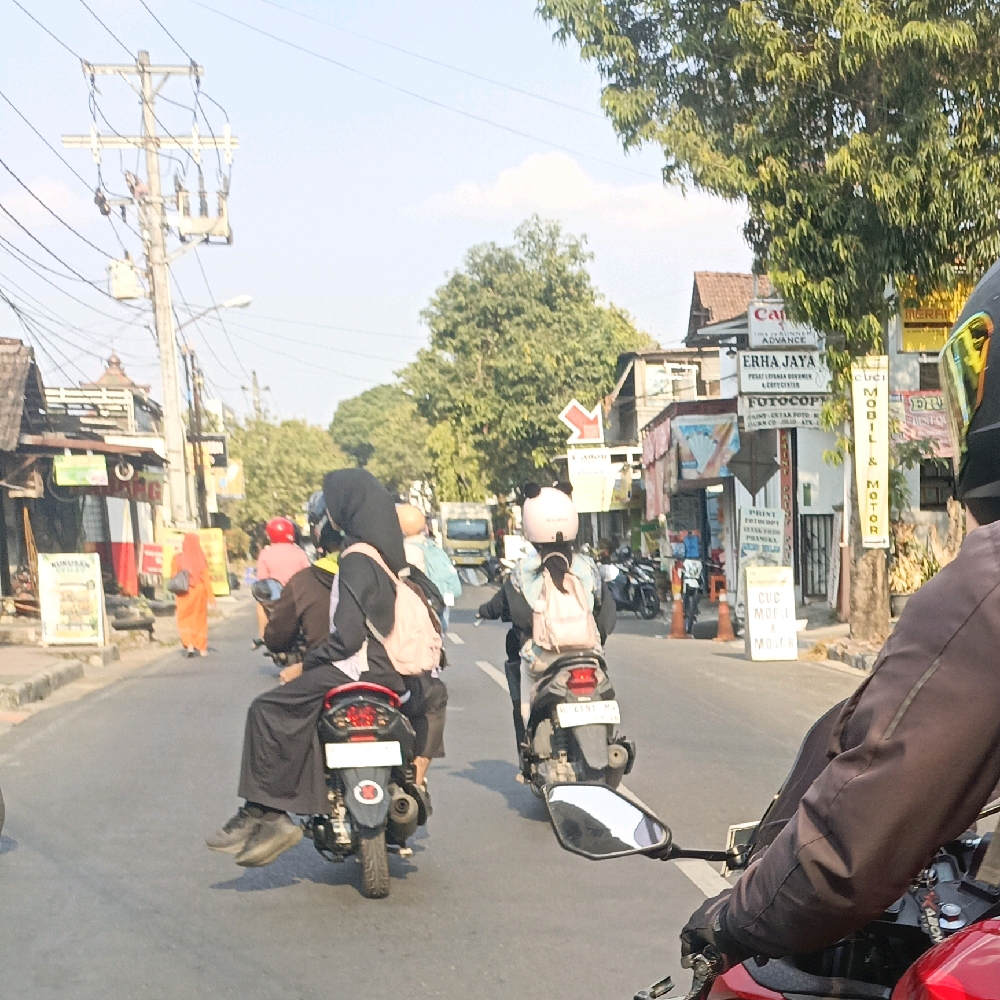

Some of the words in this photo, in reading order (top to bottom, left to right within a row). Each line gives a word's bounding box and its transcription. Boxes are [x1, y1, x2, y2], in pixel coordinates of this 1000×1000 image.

[762, 336, 807, 344] ADVANCE
[743, 355, 779, 367] ERHA
[782, 355, 815, 367] JAYA
[854, 374, 886, 382] CUCI
[863, 388, 877, 443] MOBIL
[867, 480, 879, 535] MOTOR
[749, 509, 776, 518] PRINT
